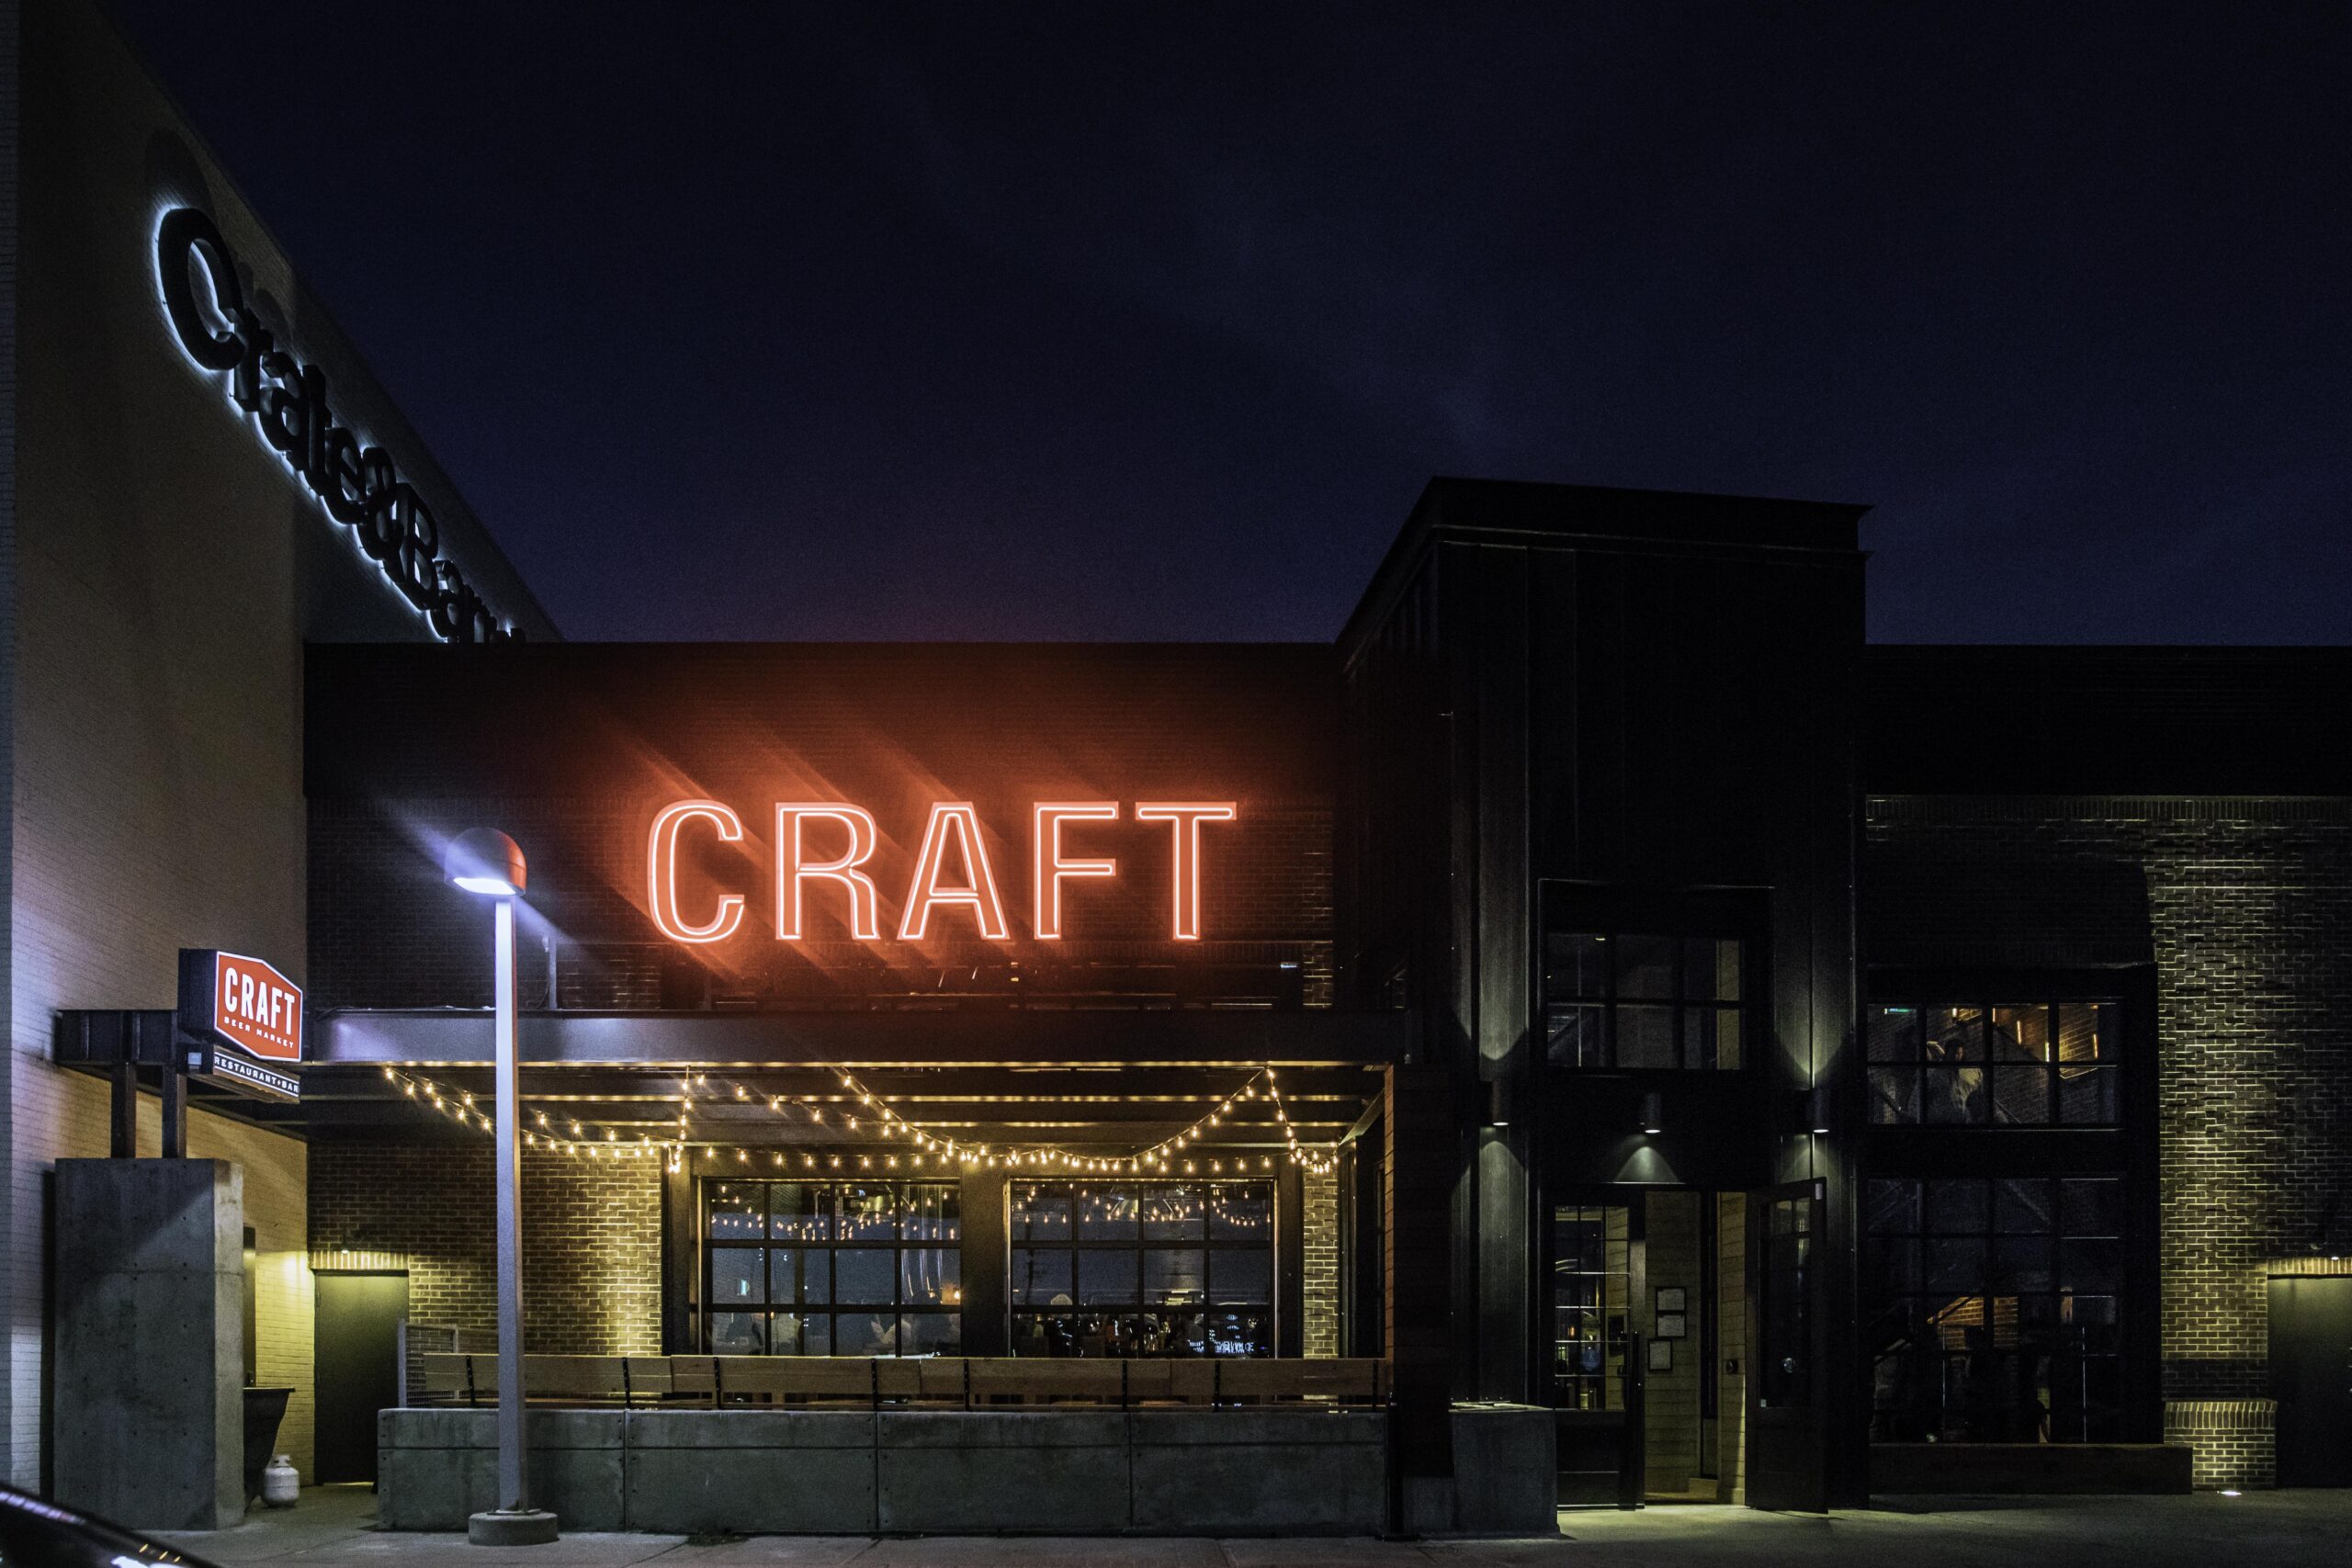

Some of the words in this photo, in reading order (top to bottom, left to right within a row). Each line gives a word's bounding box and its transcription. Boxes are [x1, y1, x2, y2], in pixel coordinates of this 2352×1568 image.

[647, 799, 1237, 943] CRAFT
[223, 1016, 251, 1032] BEER
[256, 1029, 294, 1049] MARKET
[224, 967, 295, 1035] CRAFT
